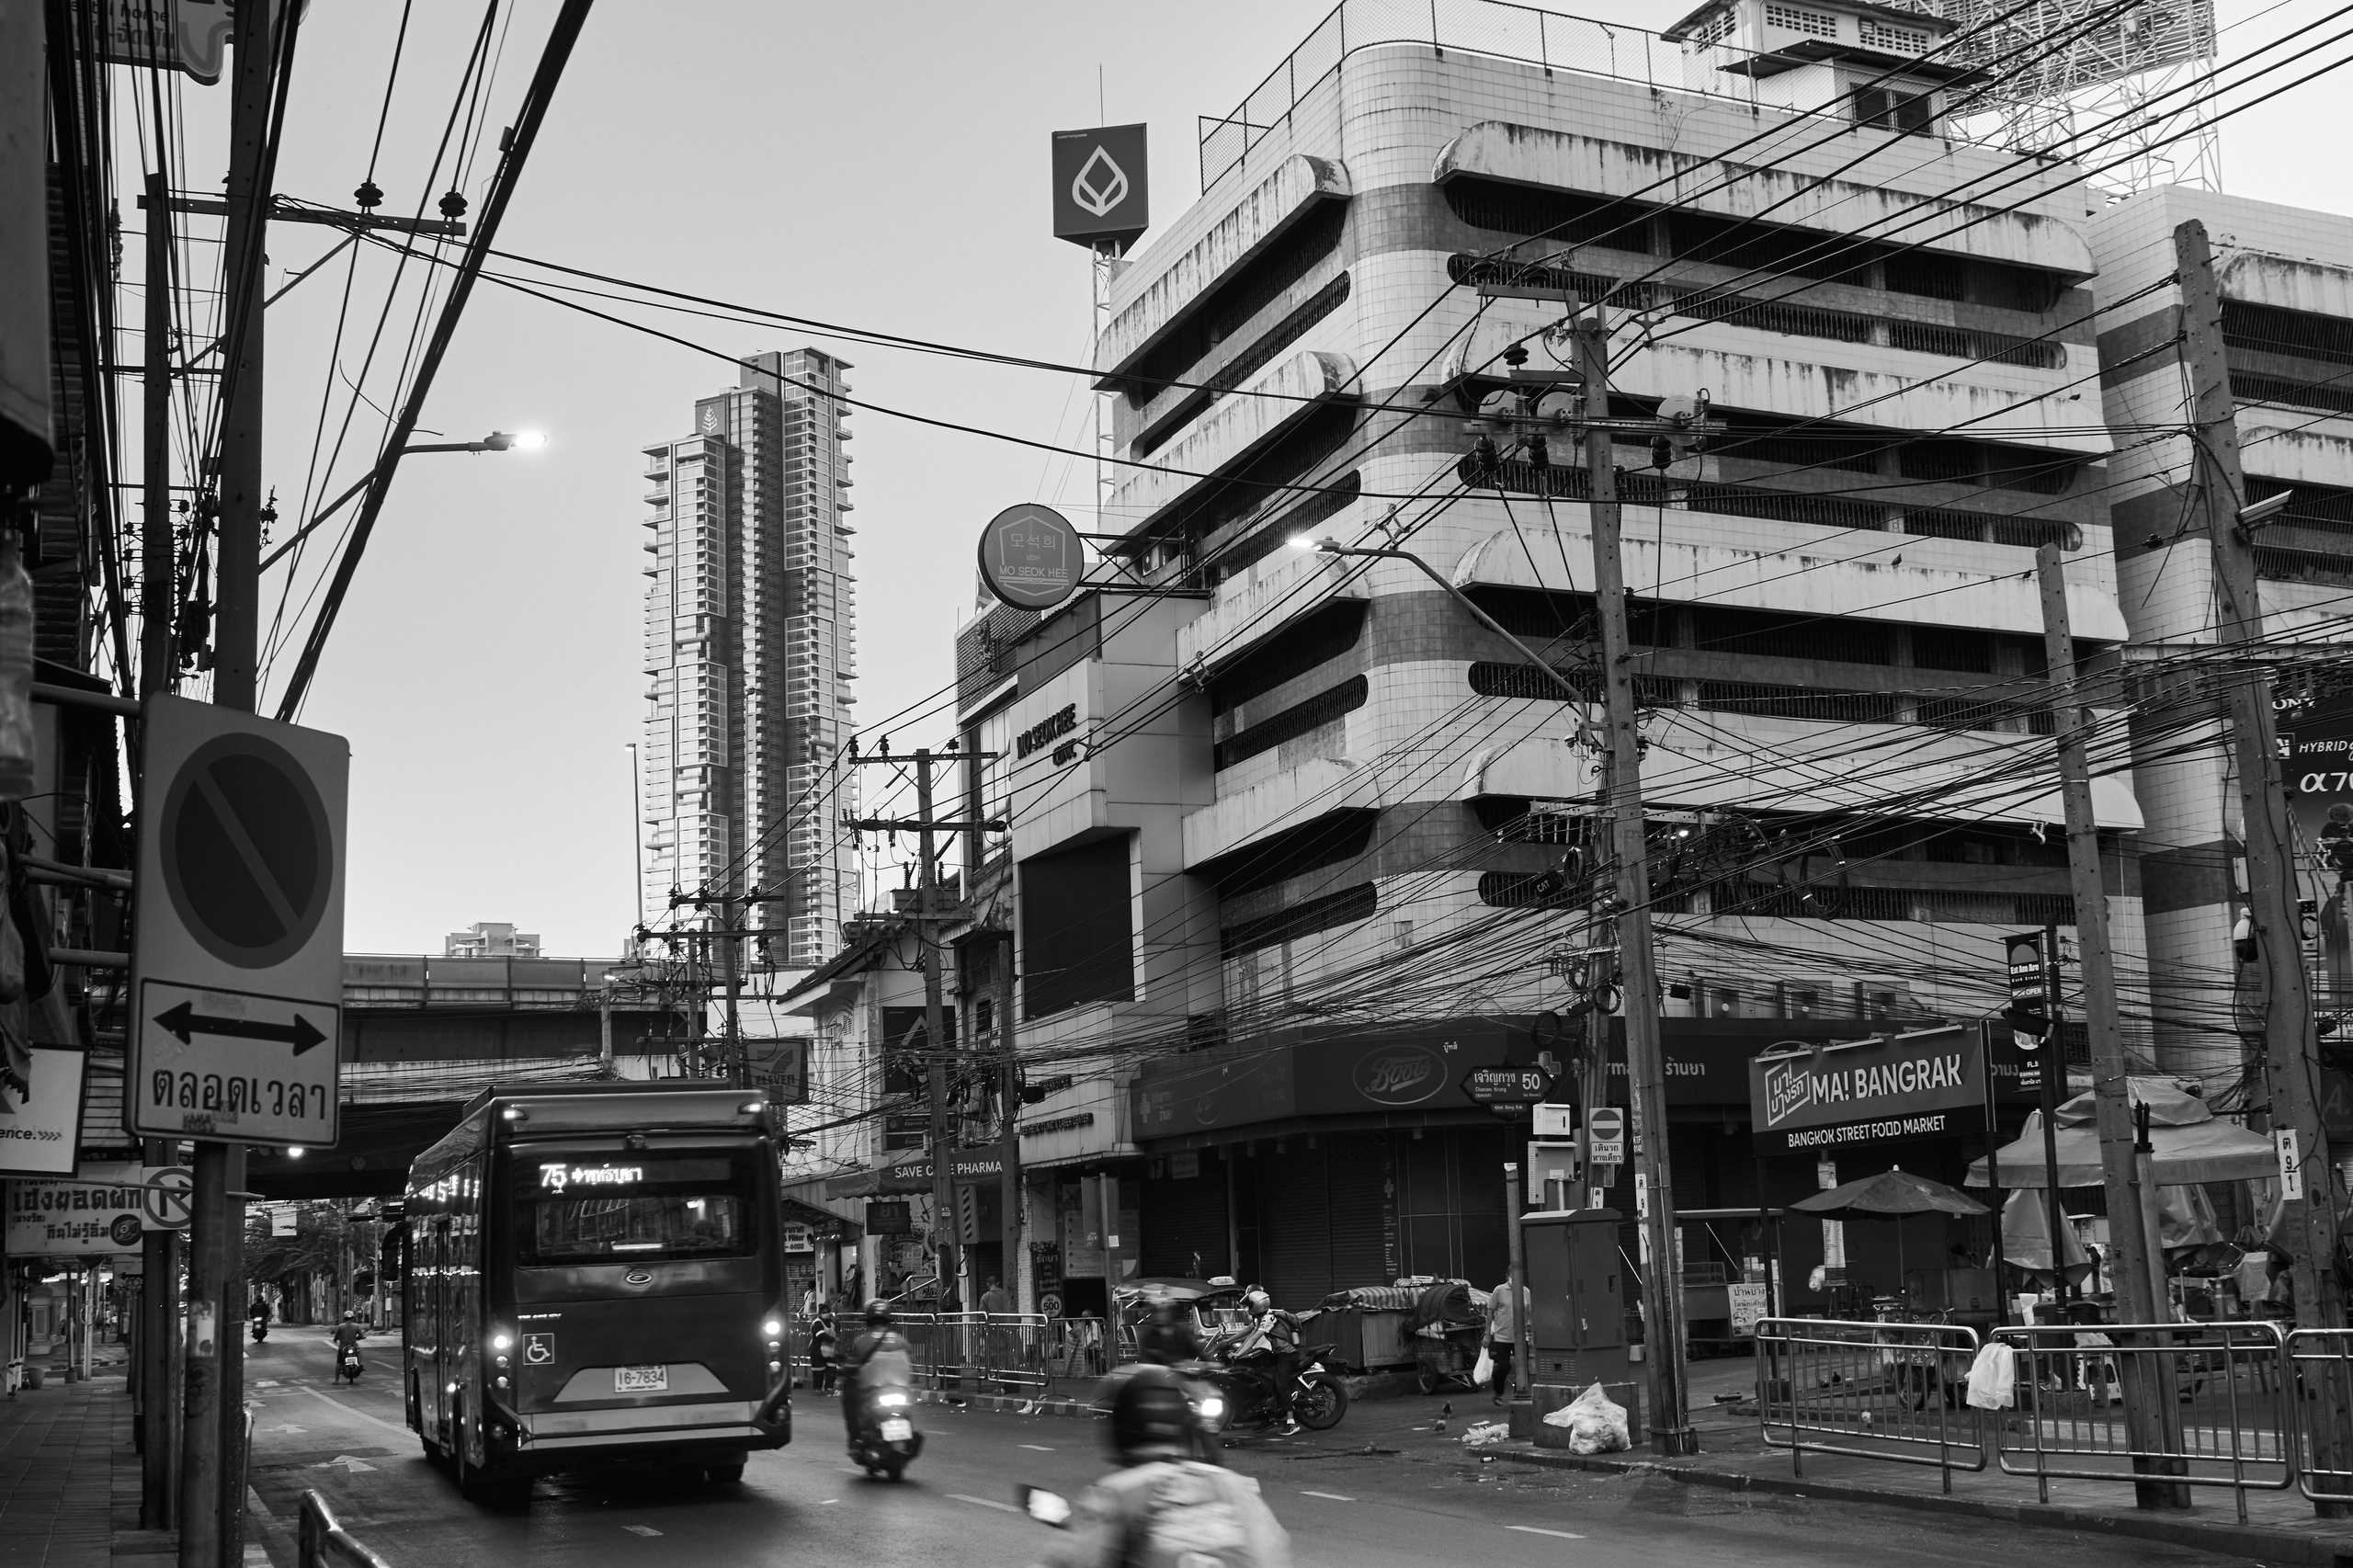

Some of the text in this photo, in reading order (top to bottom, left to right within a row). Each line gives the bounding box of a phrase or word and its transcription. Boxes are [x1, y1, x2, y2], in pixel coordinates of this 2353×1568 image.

[1010, 533, 1056, 550] 모석희
[999, 565, 1068, 578] MO SEOK HEE
[2271, 698, 2316, 710] ONY
[1017, 703, 1076, 760] MO SEOK HEE
[2299, 740, 2348, 753] HYBRID
[2025, 987, 2042, 995] OPEN
[1364, 1055, 1431, 1093] Boots
[1665, 1056, 1705, 1076] ร้านยา
[1474, 1069, 1540, 1090] เจริญกรุง 50
[1812, 1053, 1962, 1105] MA! BANGRAK
[153, 1069, 326, 1120] ตลอดเวลา
[1771, 1077, 1804, 1113] บางรัก
[1788, 1115, 1946, 1148] BANGKOK STREET FOOD MARKET
[1595, 1143, 1619, 1152] เดินรถ
[1592, 1153, 1621, 1162] ทางเดียว
[540, 1164, 568, 1187] 75
[894, 1165, 923, 1178] SAVE
[926, 1164, 955, 1176] CE
[47, 1218, 110, 1244] กินไม่รู้อิ่ม
[1036, 1254, 1059, 1264] รักษา
[1043, 1301, 1060, 1312] 500
